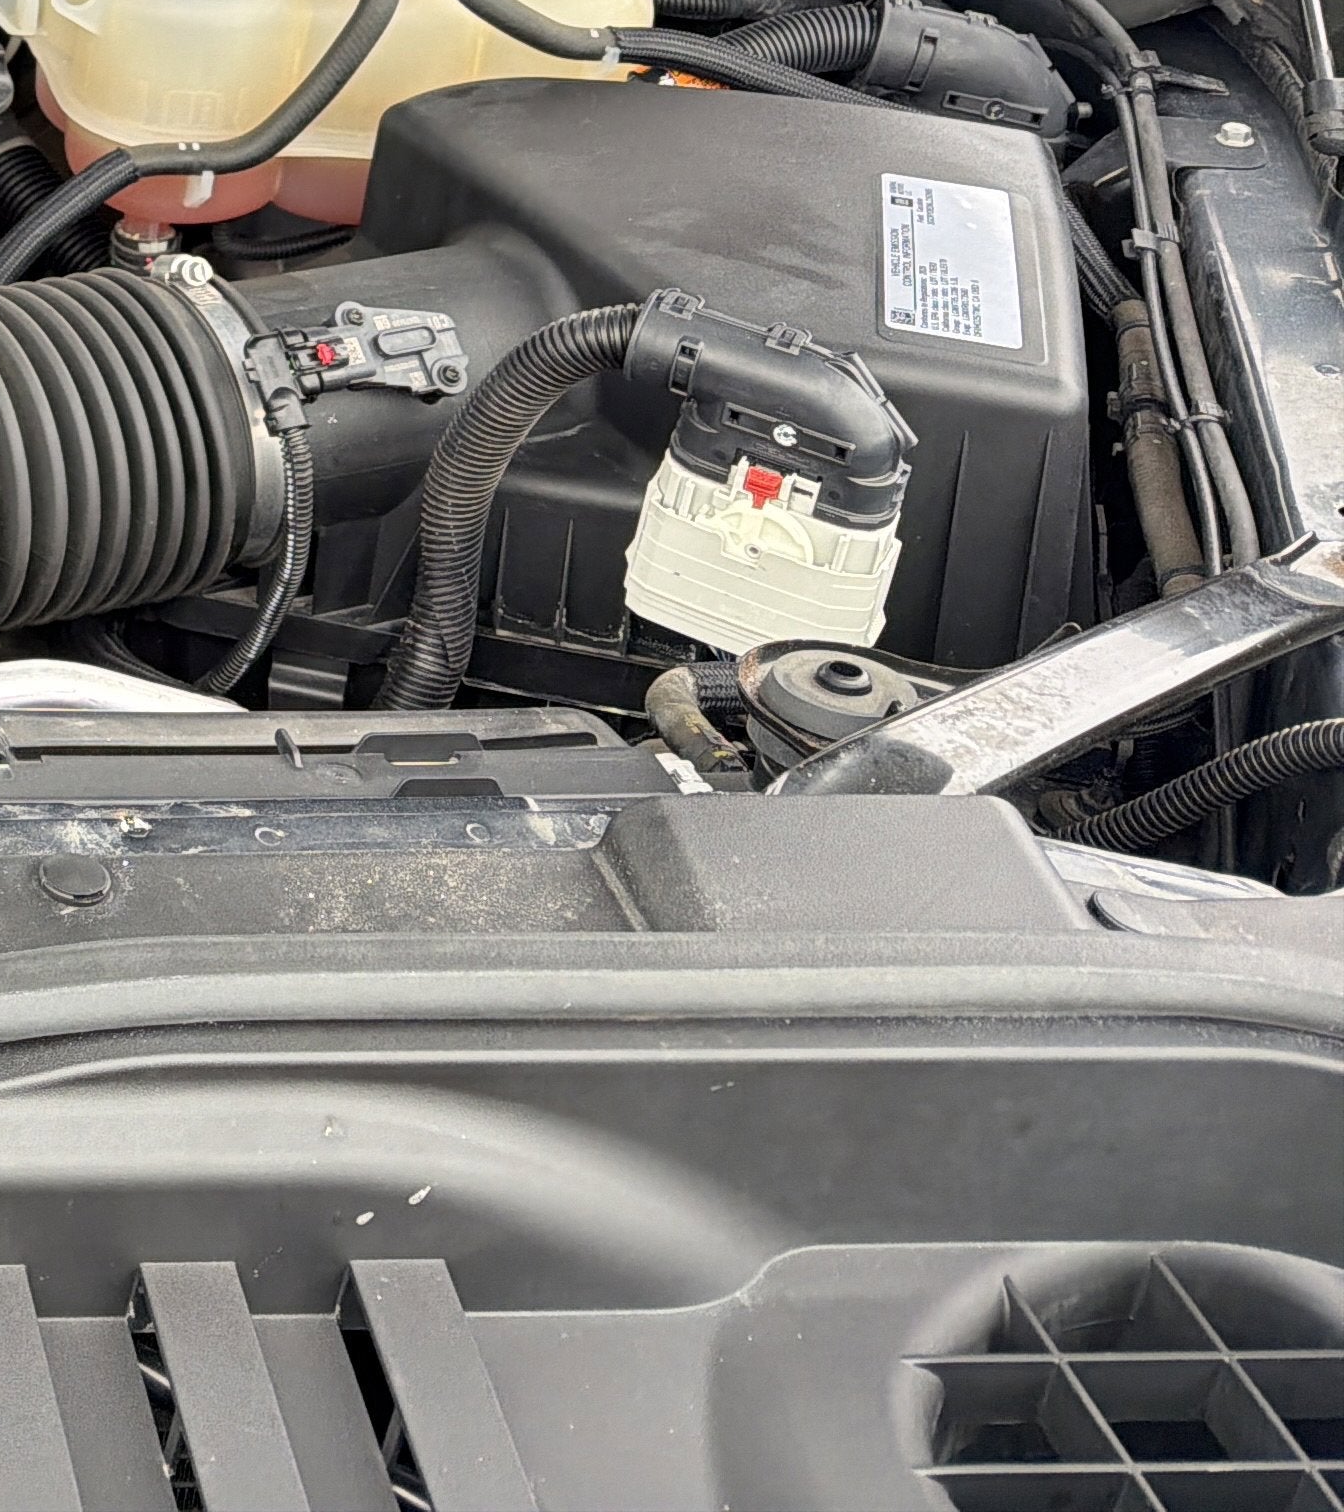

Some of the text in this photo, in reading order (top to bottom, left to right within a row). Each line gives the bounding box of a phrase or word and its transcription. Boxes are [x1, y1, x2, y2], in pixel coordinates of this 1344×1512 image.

[890, 228, 900, 276] VEHICLE EMISSION
[901, 224, 912, 287] CONTROL INFORMATION
